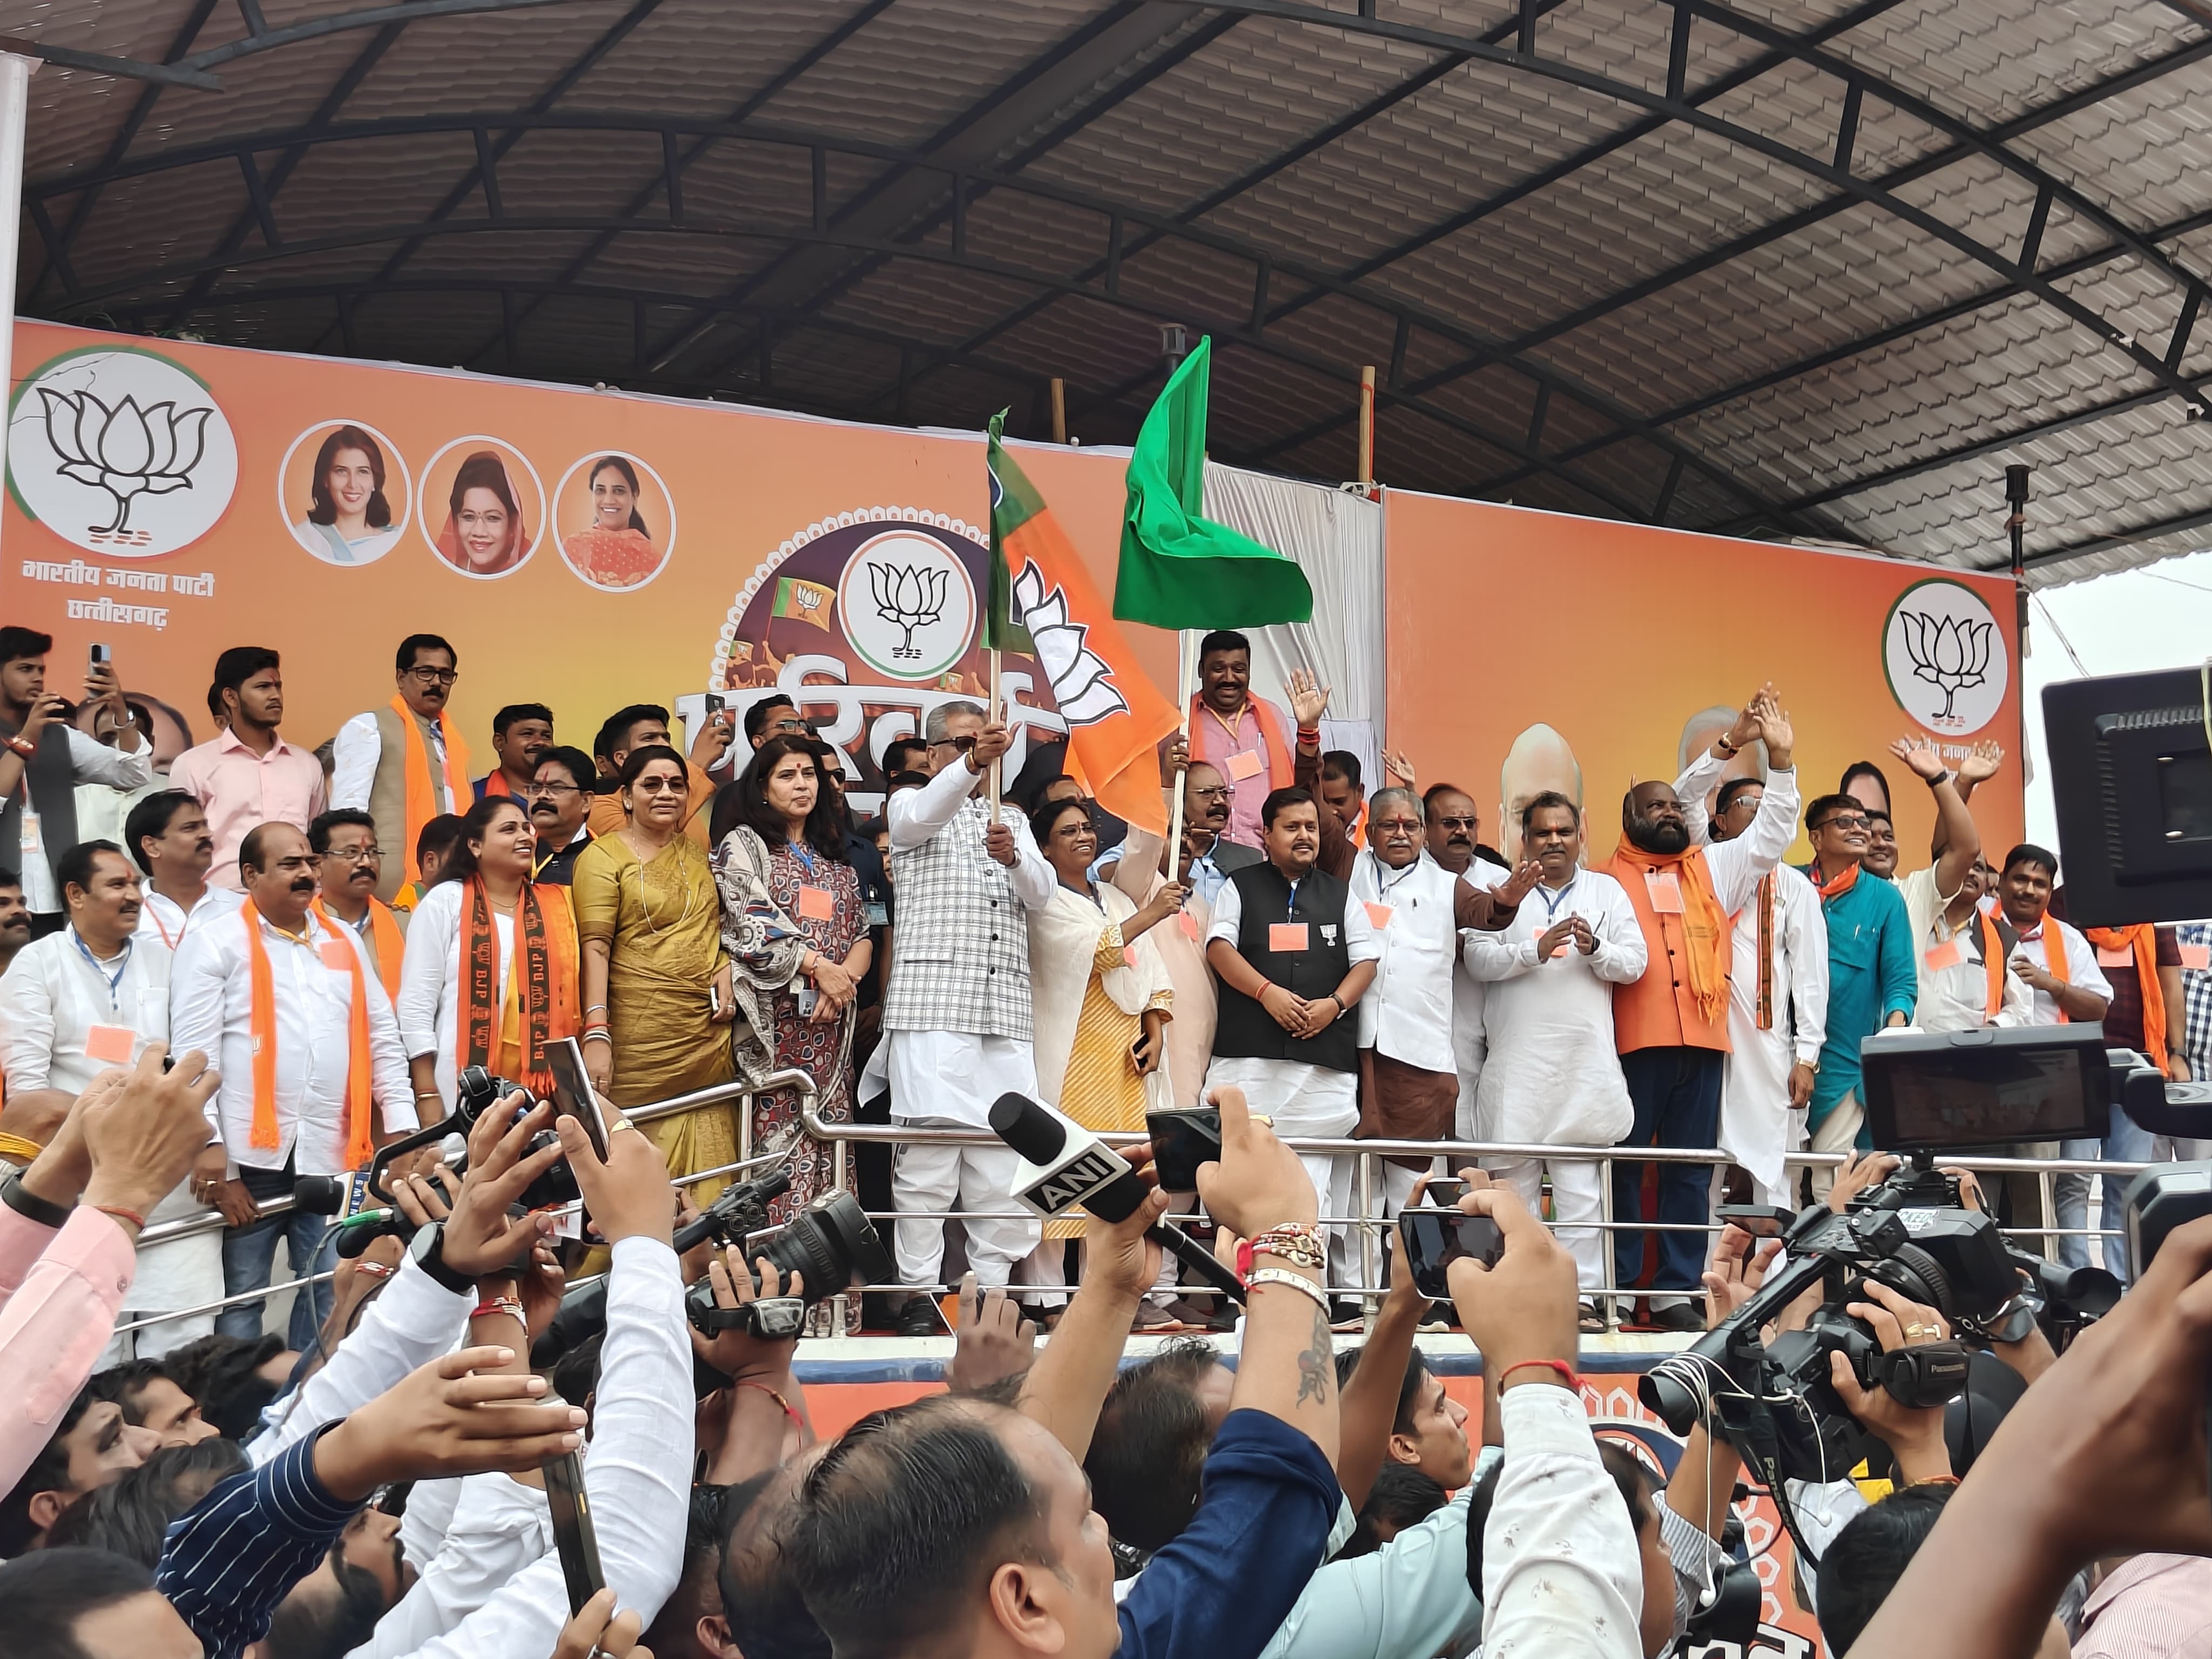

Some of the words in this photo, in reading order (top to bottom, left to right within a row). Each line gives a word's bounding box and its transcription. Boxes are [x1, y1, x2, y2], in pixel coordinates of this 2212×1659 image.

[23, 559, 102, 586] भारतीय
[106, 568, 169, 593] जनता
[532, 953, 544, 982] BJP
[475, 969, 487, 999] BJP
[1041, 1155, 1110, 1210] ANI
